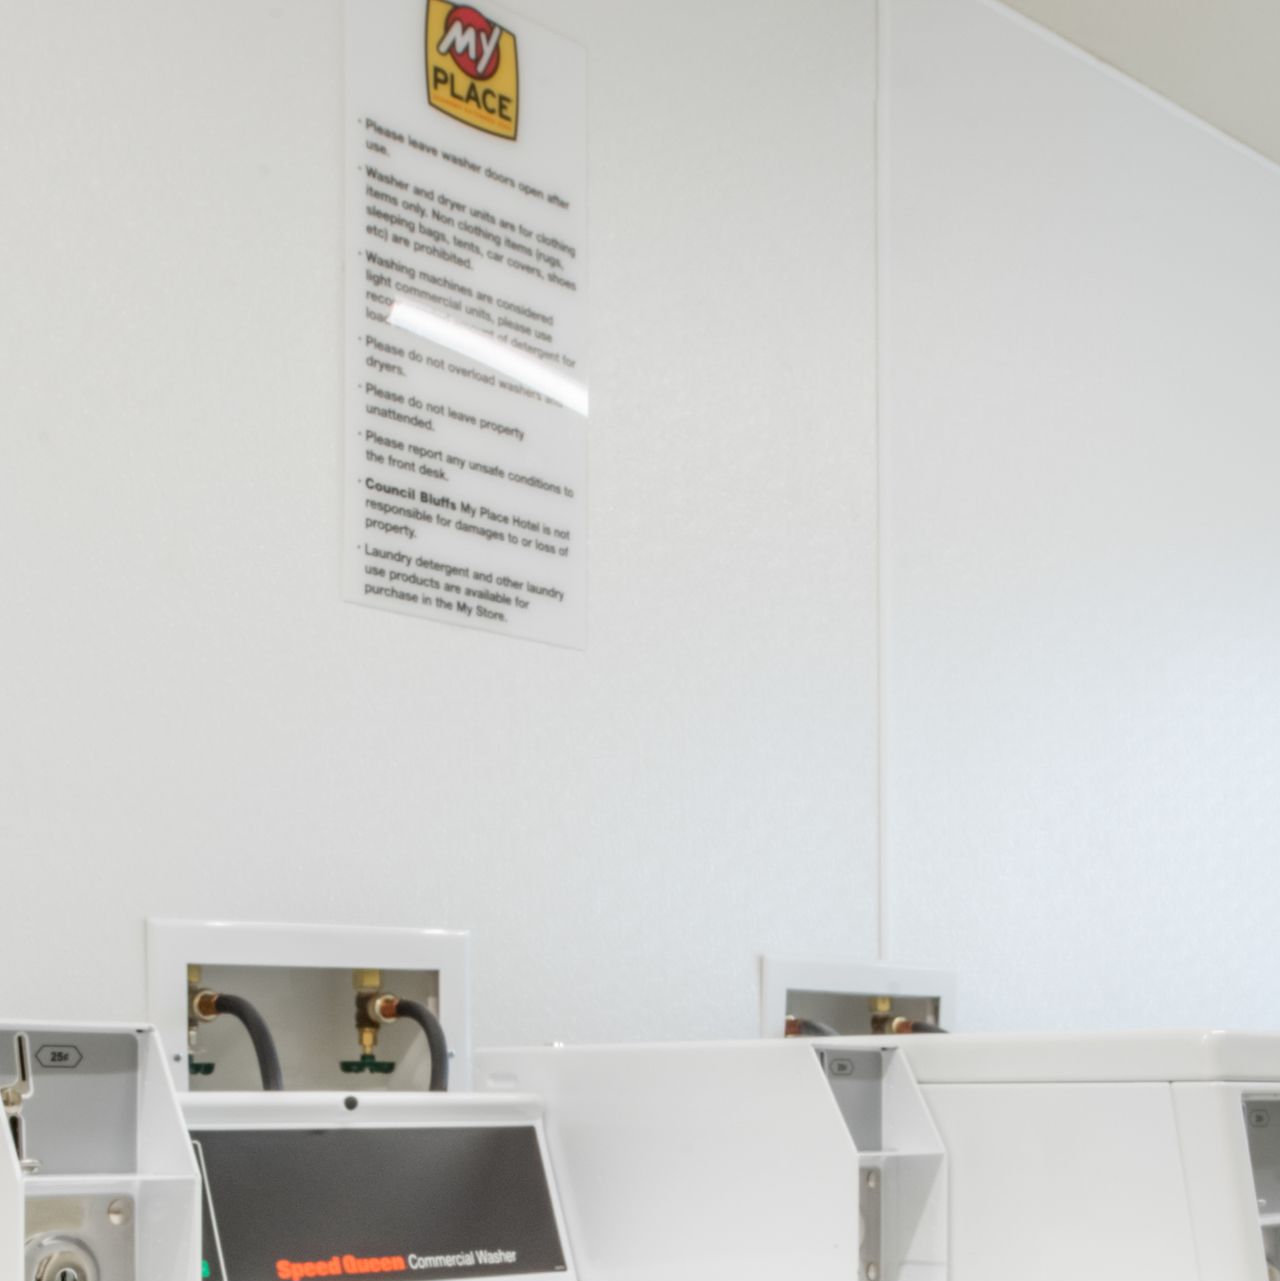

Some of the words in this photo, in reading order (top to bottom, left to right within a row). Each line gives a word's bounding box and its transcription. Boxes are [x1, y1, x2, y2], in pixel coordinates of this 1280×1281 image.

[432, 65, 513, 122] PLACE
[365, 118, 405, 144] Please
[408, 135, 438, 157] leave
[441, 149, 481, 174] washer
[484, 167, 515, 189] doors
[518, 180, 544, 201] open
[547, 192, 570, 210] after
[365, 164, 410, 191] Washer
[413, 182, 434, 202] and
[437, 191, 466, 215] dryer
[469, 206, 496, 225] units
[499, 217, 516, 232] are
[518, 220, 533, 237] for
[536, 231, 576, 258] clothing
[366, 185, 398, 207] items
[402, 197, 428, 219] only.
[431, 207, 455, 227] Non
[458, 216, 501, 247] clothing
[504, 236, 533, 257] items
[366, 203, 415, 233] sleeping
[419, 219, 450, 244] bags,
[453, 235, 484, 257] tents,
[486, 246, 504, 262] car
[507, 256, 544, 280] covers,
[547, 272, 577, 292] shoes
[366, 225, 388, 242] etc)
[391, 233, 410, 249] are
[413, 238, 474, 271] prohibited.
[365, 250, 416, 279] Washing
[419, 267, 473, 298] machines
[476, 290, 493, 305] are
[496, 295, 554, 326] considered
[366, 269, 391, 289] light
[395, 279, 462, 312] commercial
[465, 304, 495, 324] units,
[497, 314, 532, 336] please
[534, 327, 553, 343] use
[365, 335, 405, 358] Please
[408, 350, 423, 364] do
[426, 355, 445, 371] not
[447, 362, 495, 387] overload
[498, 378, 542, 402] washers
[366, 356, 406, 377] dryers.
[562, 352, 576, 368] for
[365, 382, 405, 405] Please
[408, 397, 423, 410] do
[426, 401, 445, 416] not
[447, 407, 476, 426] leave
[479, 419, 525, 442] property
[366, 403, 435, 432] unattended.
[365, 429, 405, 451] Please
[408, 443, 443, 463] report
[446, 454, 465, 470] any
[468, 458, 505, 480] unsafe
[508, 470, 561, 496] conditions
[564, 485, 574, 498] to
[366, 449, 384, 465] the
[388, 455, 416, 473] front
[419, 463, 450, 482] desk.
[365, 477, 416, 501] Council
[420, 491, 457, 512] Bluffs
[460, 502, 476, 518] My
[480, 506, 509, 525] Place
[512, 515, 541, 533] Hotel
[543, 522, 551, 535] is
[554, 527, 571, 541] not
[365, 499, 433, 524] responsible
[436, 515, 451, 529] for
[455, 520, 504, 543] damages
[508, 532, 518, 545] to
[521, 536, 532, 548] or
[535, 540, 556, 555] loss
[559, 546, 569, 557] of
[365, 517, 417, 540] property.
[364, 543, 413, 567] Laundry
[416, 554, 469, 580] detergent
[473, 569, 493, 584] and
[496, 574, 524, 591] other
[527, 580, 564, 602] laundry
[365, 564, 385, 578] use
[389, 568, 440, 591] products
[443, 581, 461, 594] are
[464, 584, 512, 608] available
[515, 597, 530, 610] for
[364, 583, 418, 603] purchase
[422, 592, 433, 606] in
[435, 596, 453, 611] the
[456, 601, 473, 617] My
[475, 605, 508, 623] Store.
[343, 1254, 407, 1274] Queen
[408, 1252, 475, 1269] Commercial
[475, 1249, 517, 1267] Washer
